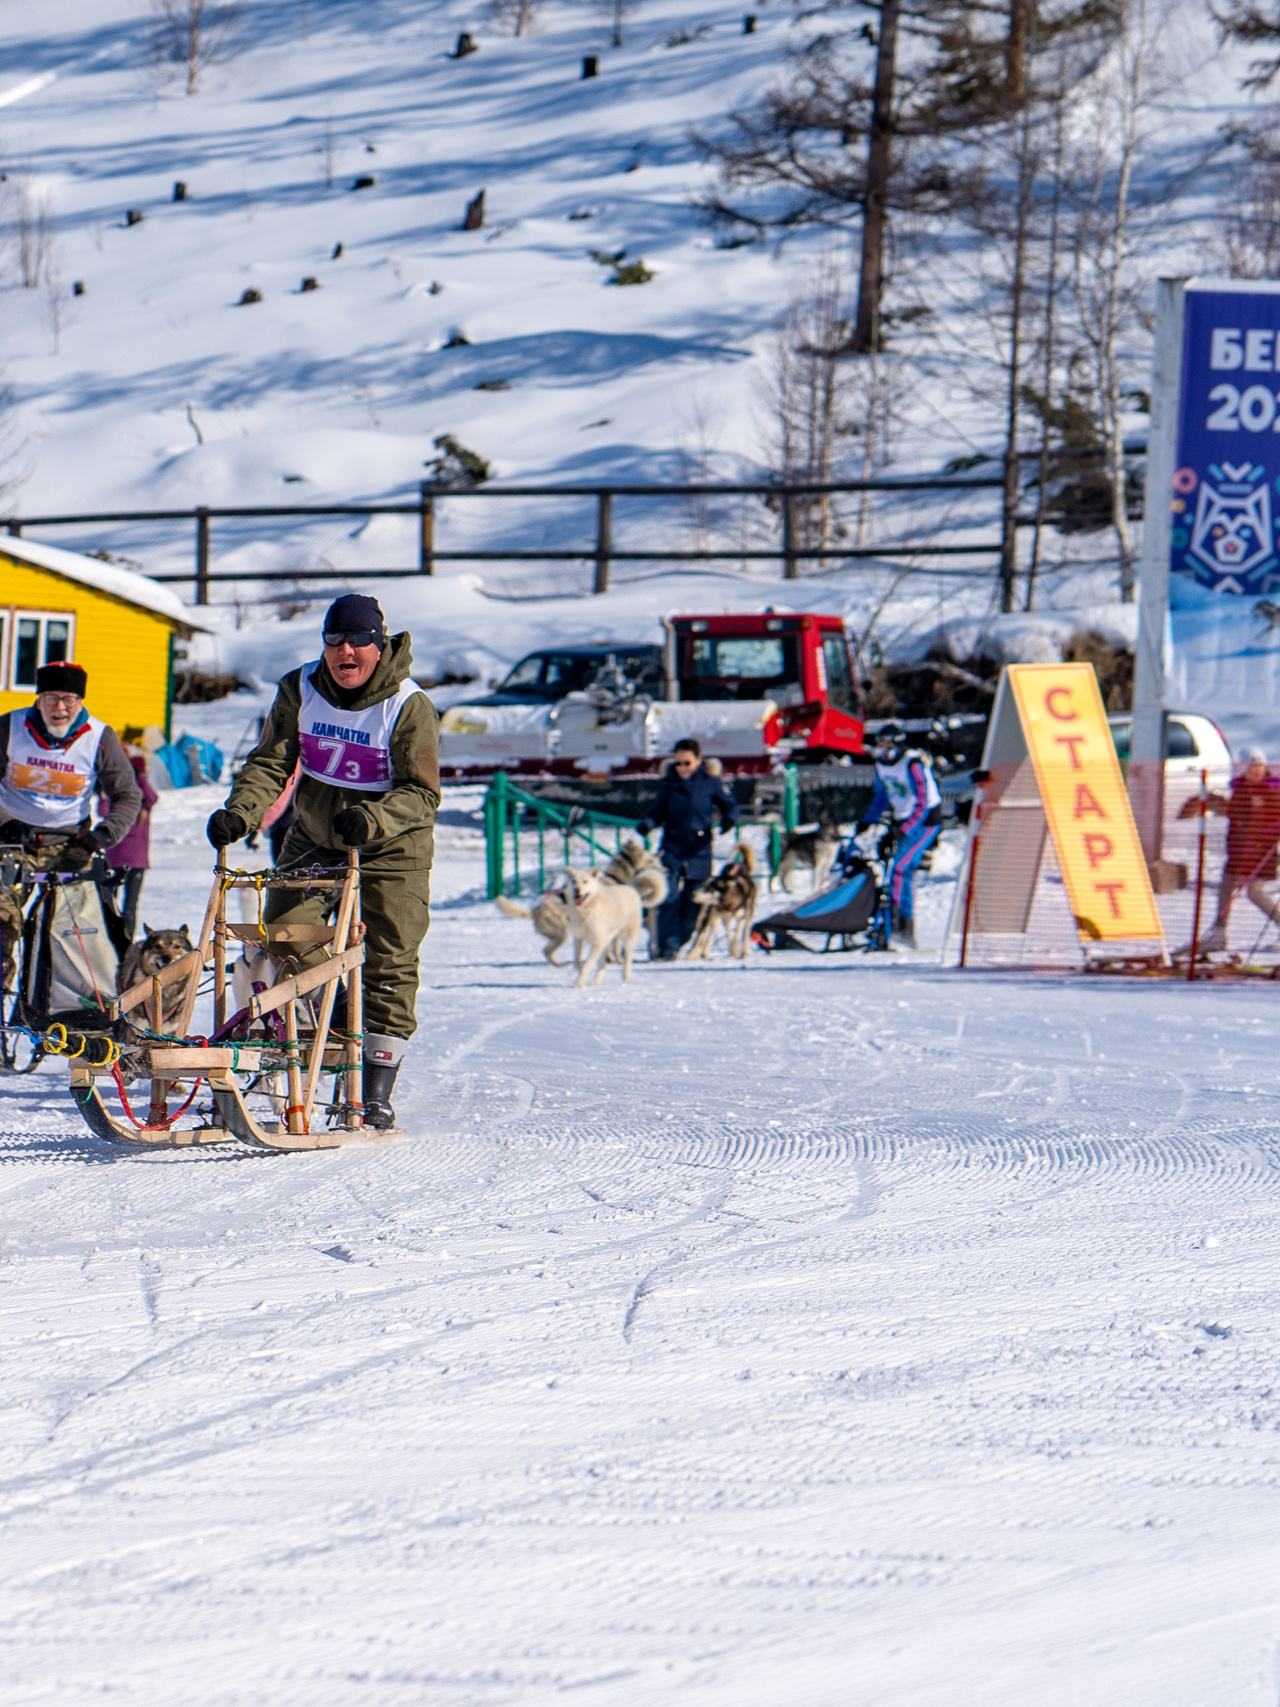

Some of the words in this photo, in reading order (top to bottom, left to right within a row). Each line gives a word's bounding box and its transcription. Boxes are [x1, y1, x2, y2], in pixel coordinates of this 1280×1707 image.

[1210, 327, 1280, 371] БЕ
[1206, 383, 1280, 432] 20
[311, 721, 371, 746] КАМЧАТКА
[1043, 687, 1124, 918] СТАРТ
